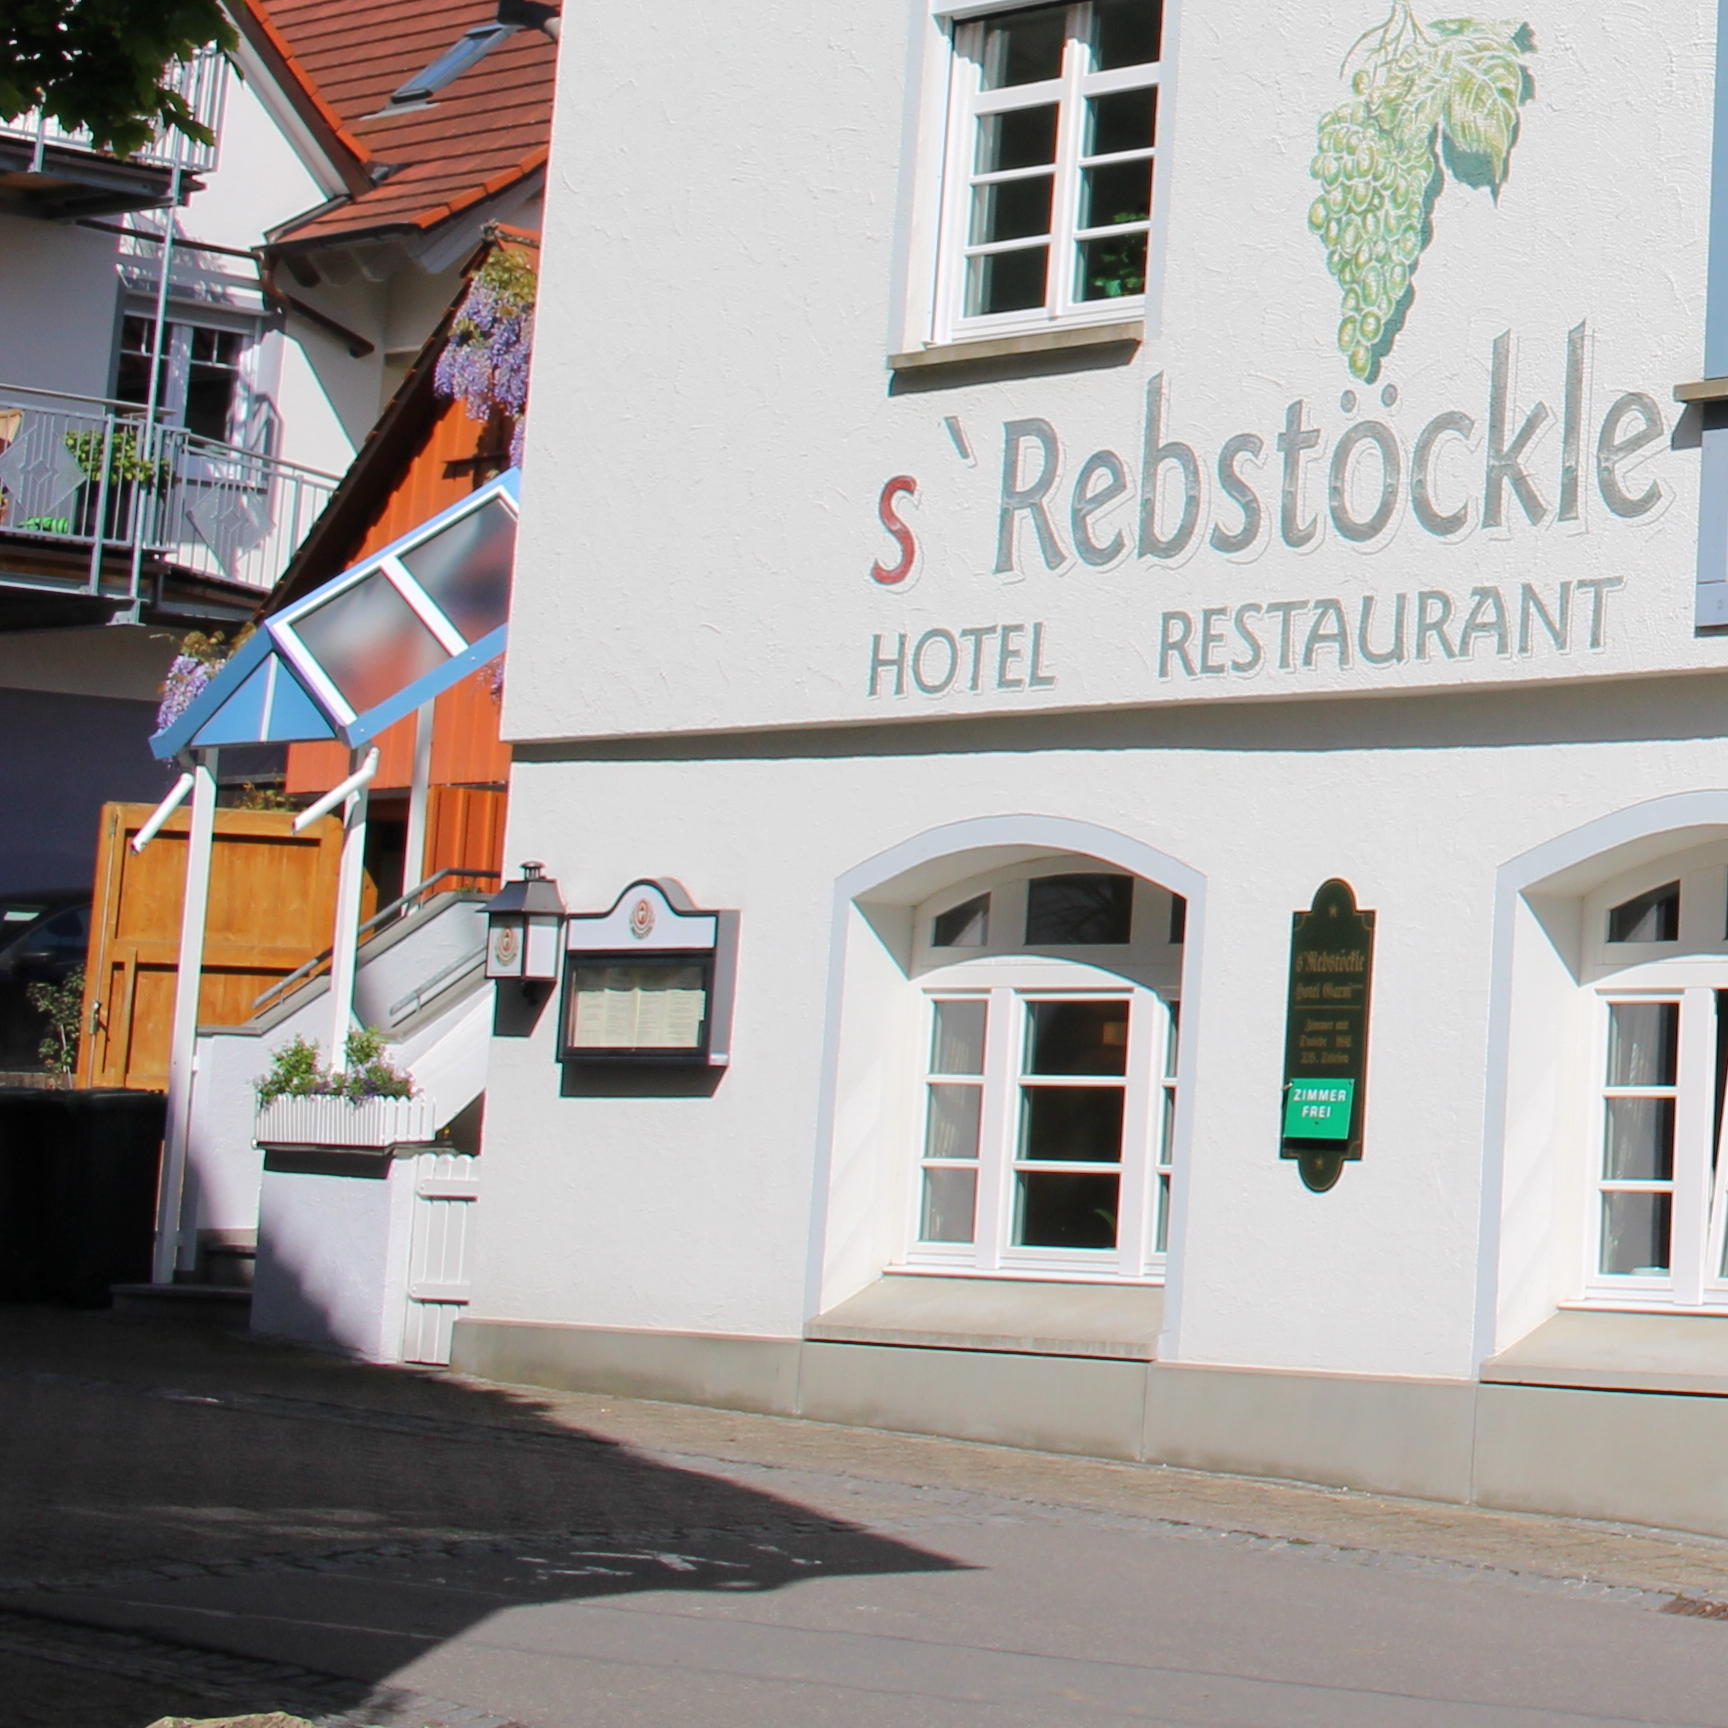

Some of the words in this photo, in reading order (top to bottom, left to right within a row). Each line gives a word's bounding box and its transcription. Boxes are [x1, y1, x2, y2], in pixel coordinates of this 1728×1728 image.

[868, 622, 1056, 697] HOTEL
[1158, 576, 1624, 679] RESTAURANT
[1293, 1089, 1347, 1102] ZIMMER
[1301, 1105, 1331, 1118] FREI
